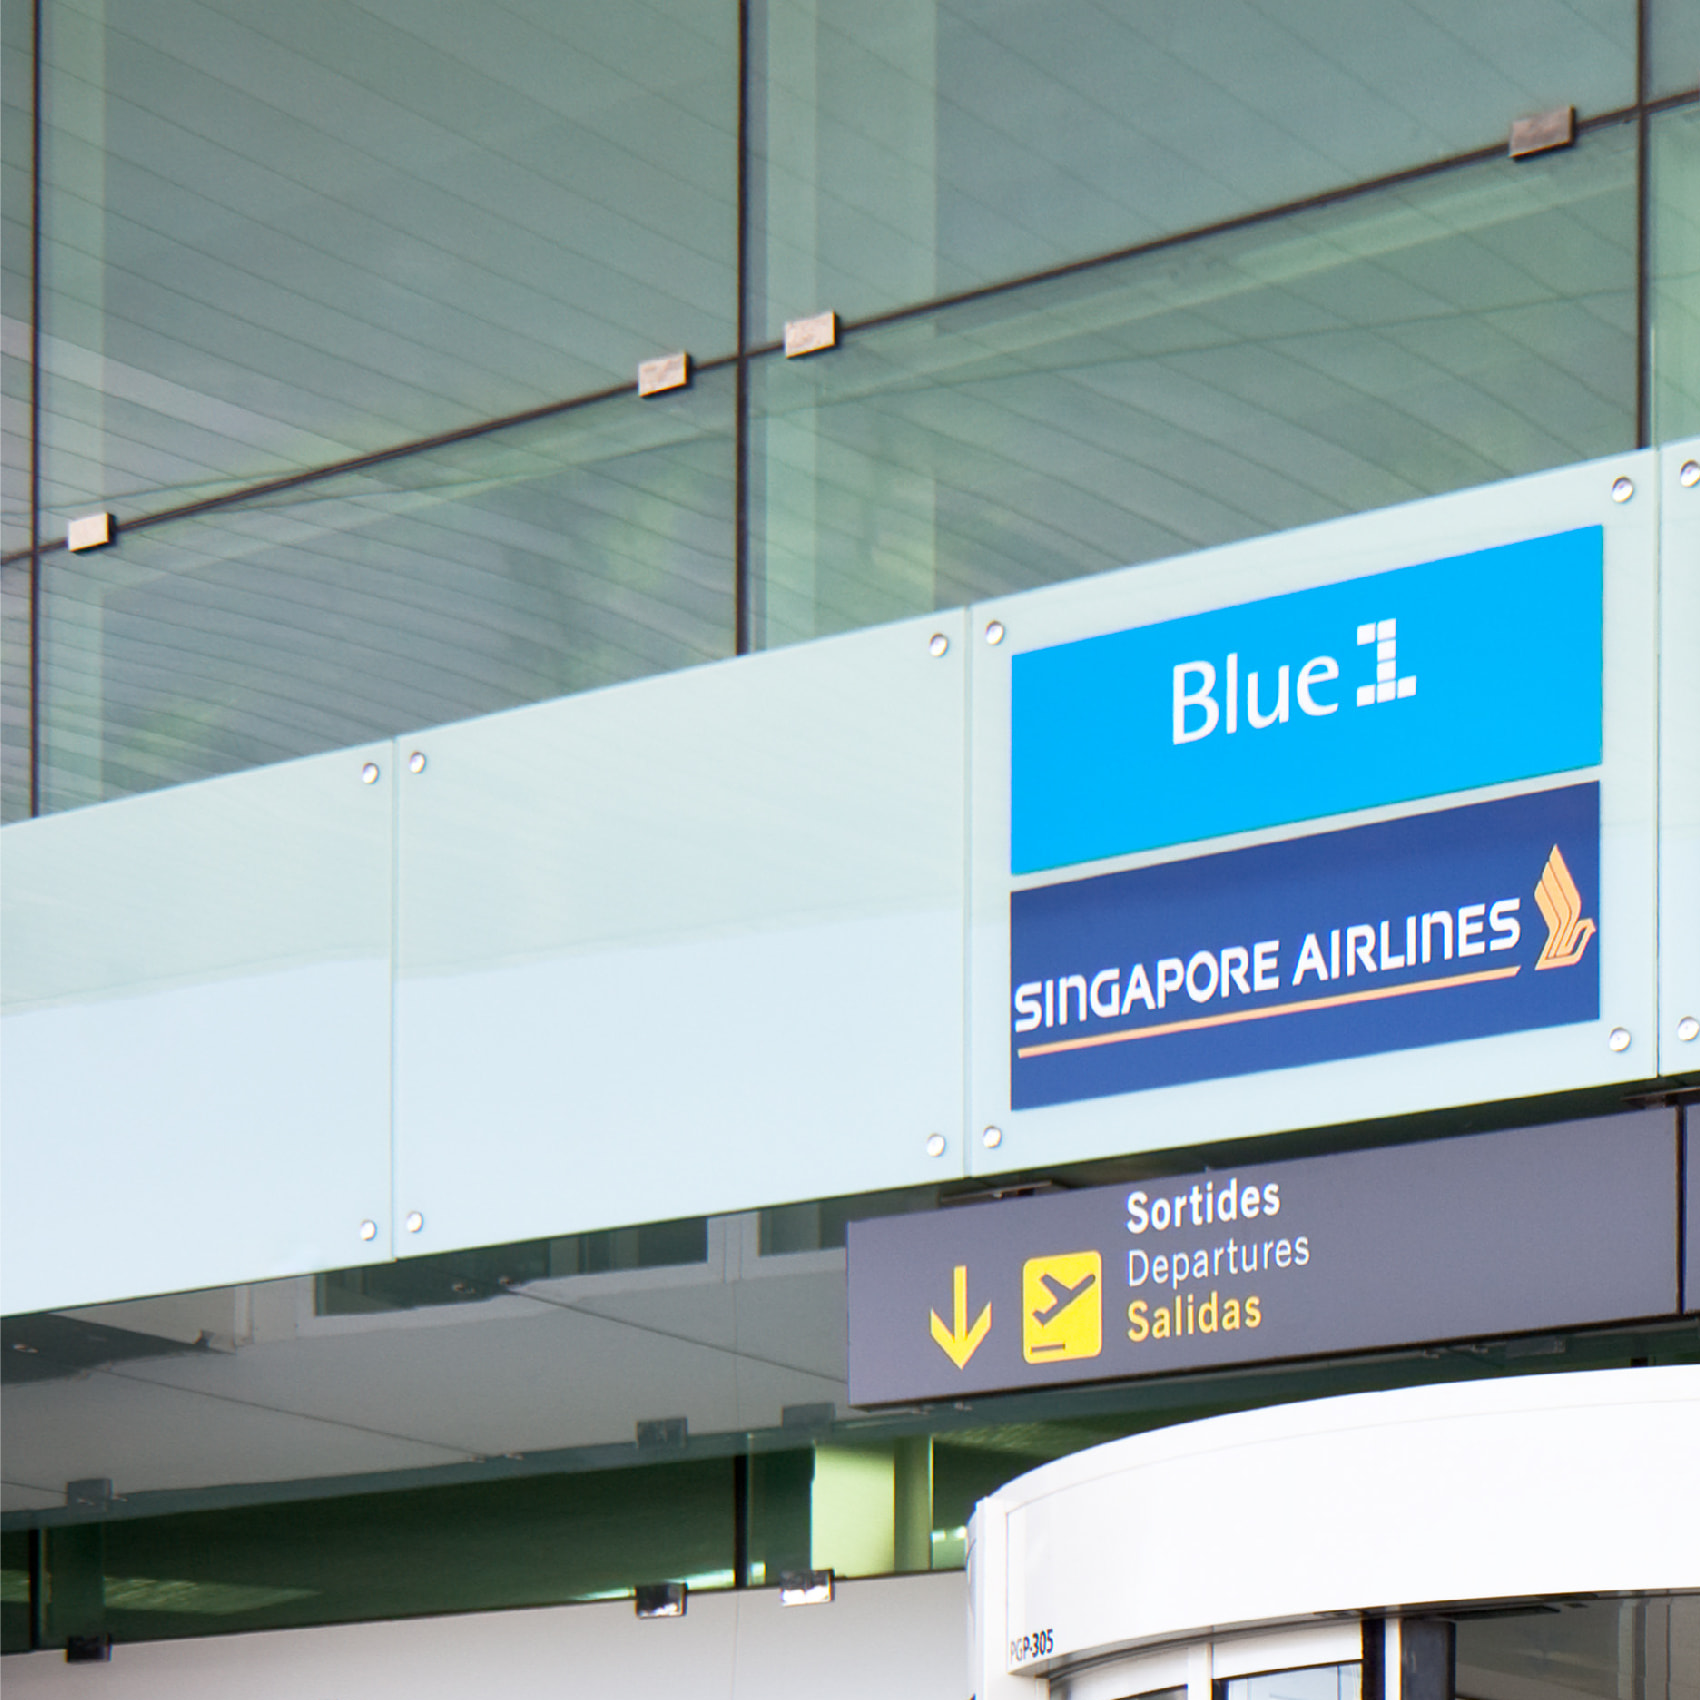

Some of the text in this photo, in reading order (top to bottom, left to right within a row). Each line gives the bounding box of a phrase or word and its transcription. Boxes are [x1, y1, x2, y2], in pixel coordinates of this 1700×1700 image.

[1014, 897, 1521, 1032] SINGAPORE AIRLINES
[1126, 1177, 1281, 1234] Sortides
[1127, 1235, 1310, 1289] Departures
[1127, 1290, 1262, 1342] Salidas
